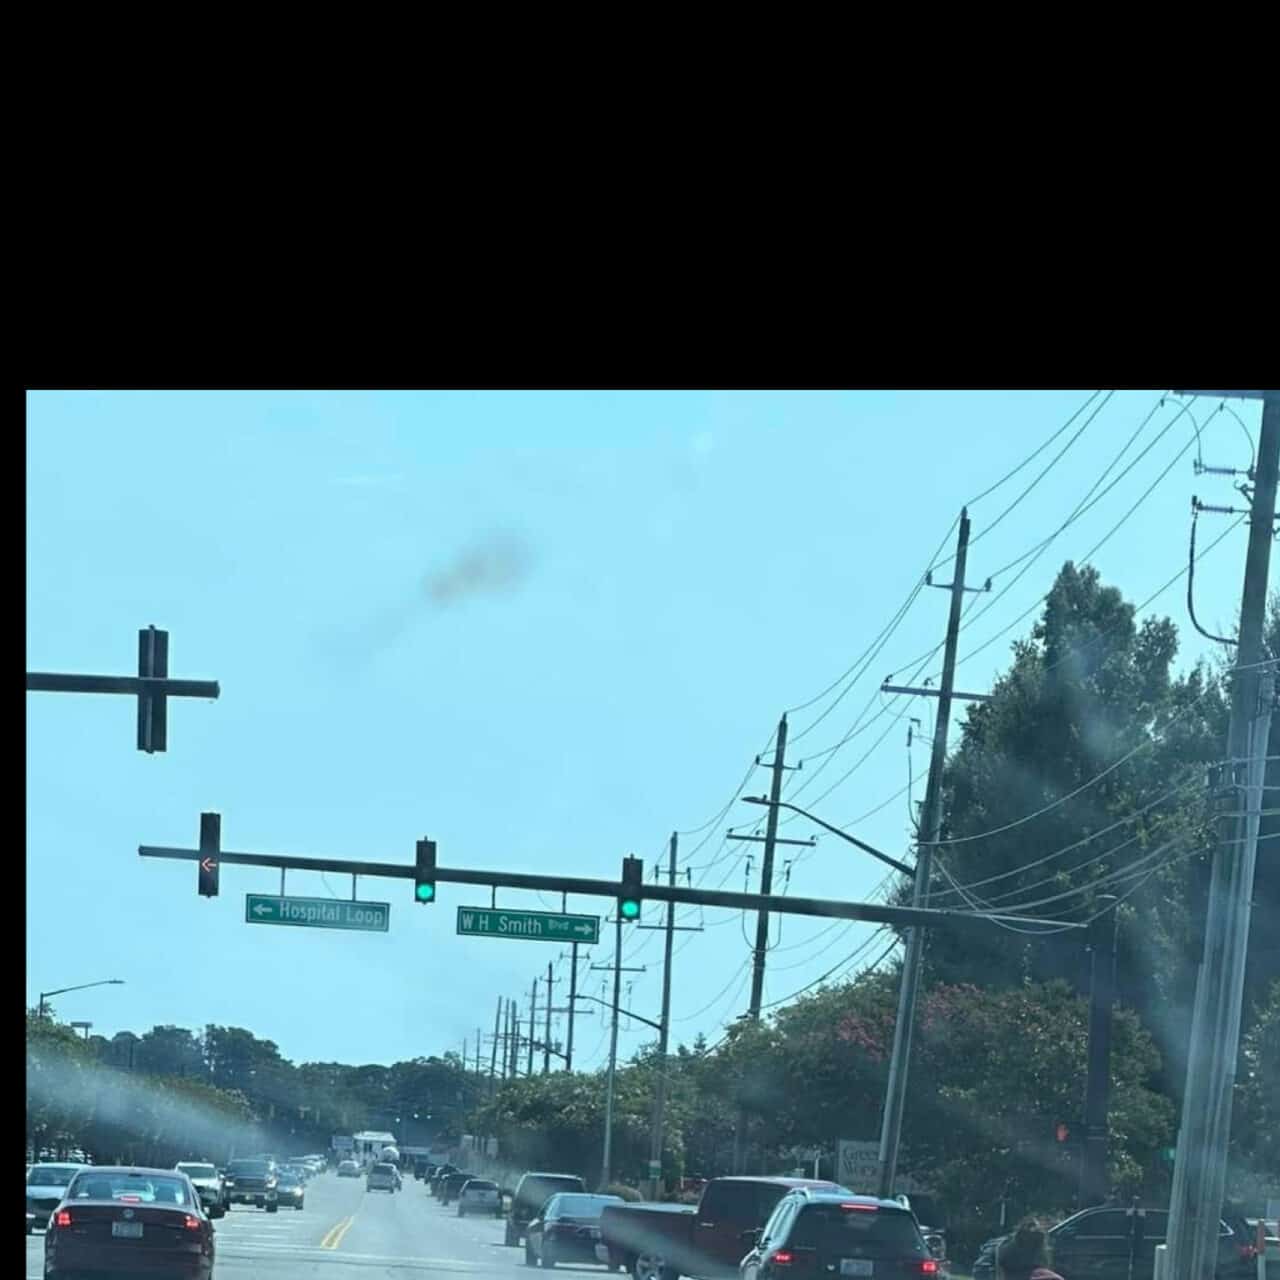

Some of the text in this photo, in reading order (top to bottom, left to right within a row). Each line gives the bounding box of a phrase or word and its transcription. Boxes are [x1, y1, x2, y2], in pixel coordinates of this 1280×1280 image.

[279, 901, 383, 925] Hospital Loop
[462, 914, 474, 930] W
[479, 915, 489, 931] H
[498, 915, 542, 935] Smith
